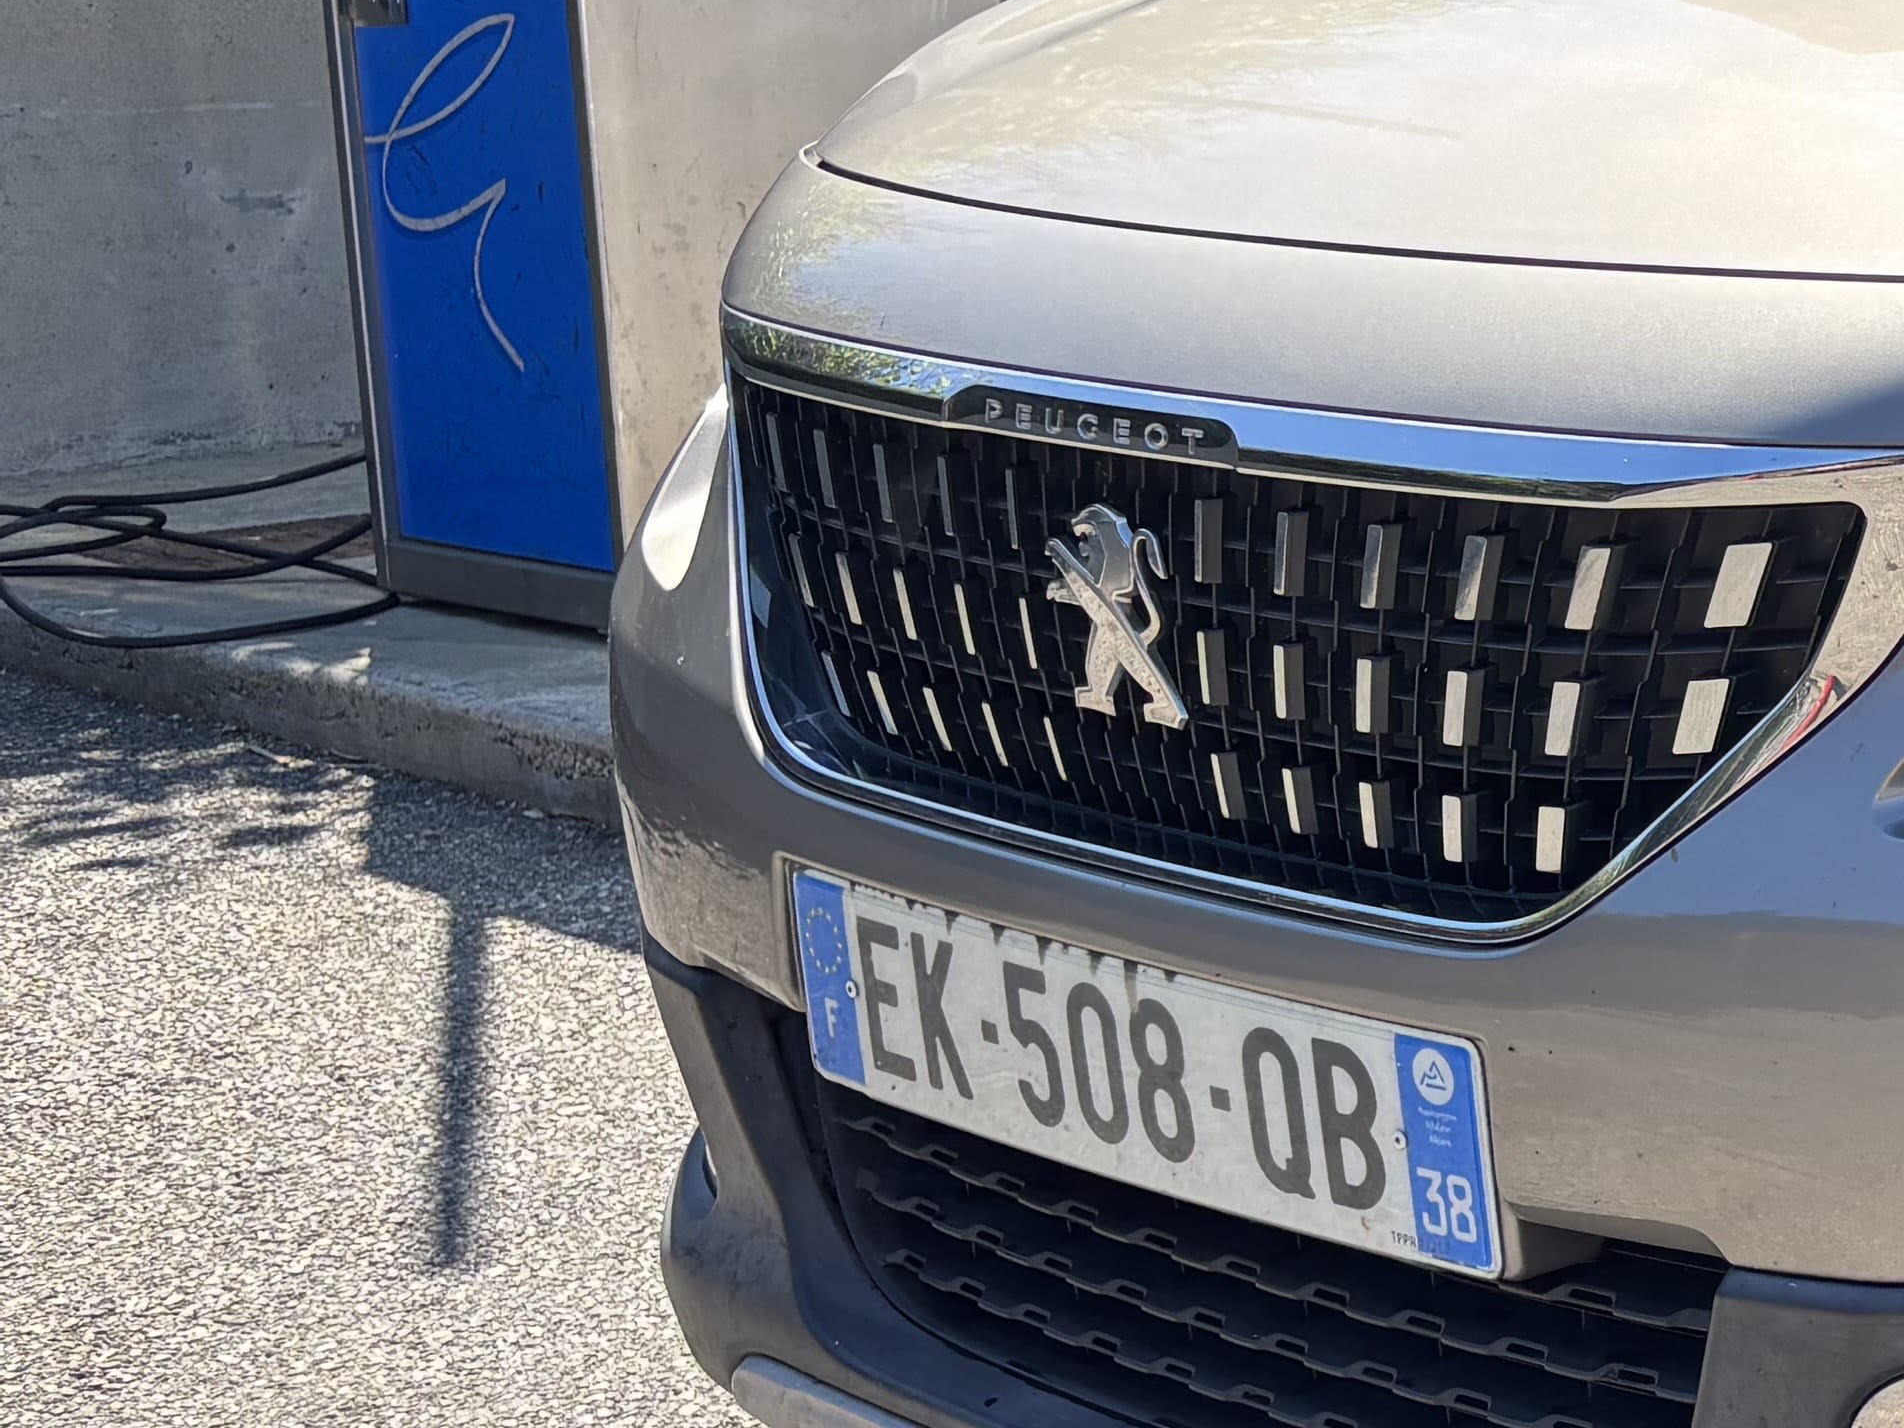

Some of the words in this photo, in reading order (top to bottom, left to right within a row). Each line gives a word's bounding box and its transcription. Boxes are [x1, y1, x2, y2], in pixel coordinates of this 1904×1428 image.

[984, 398, 1204, 455] PEUGEOT
[824, 996, 839, 1037] F
[856, 915, 1387, 1211] EK-508-QB
[1416, 1166, 1478, 1244] 38
